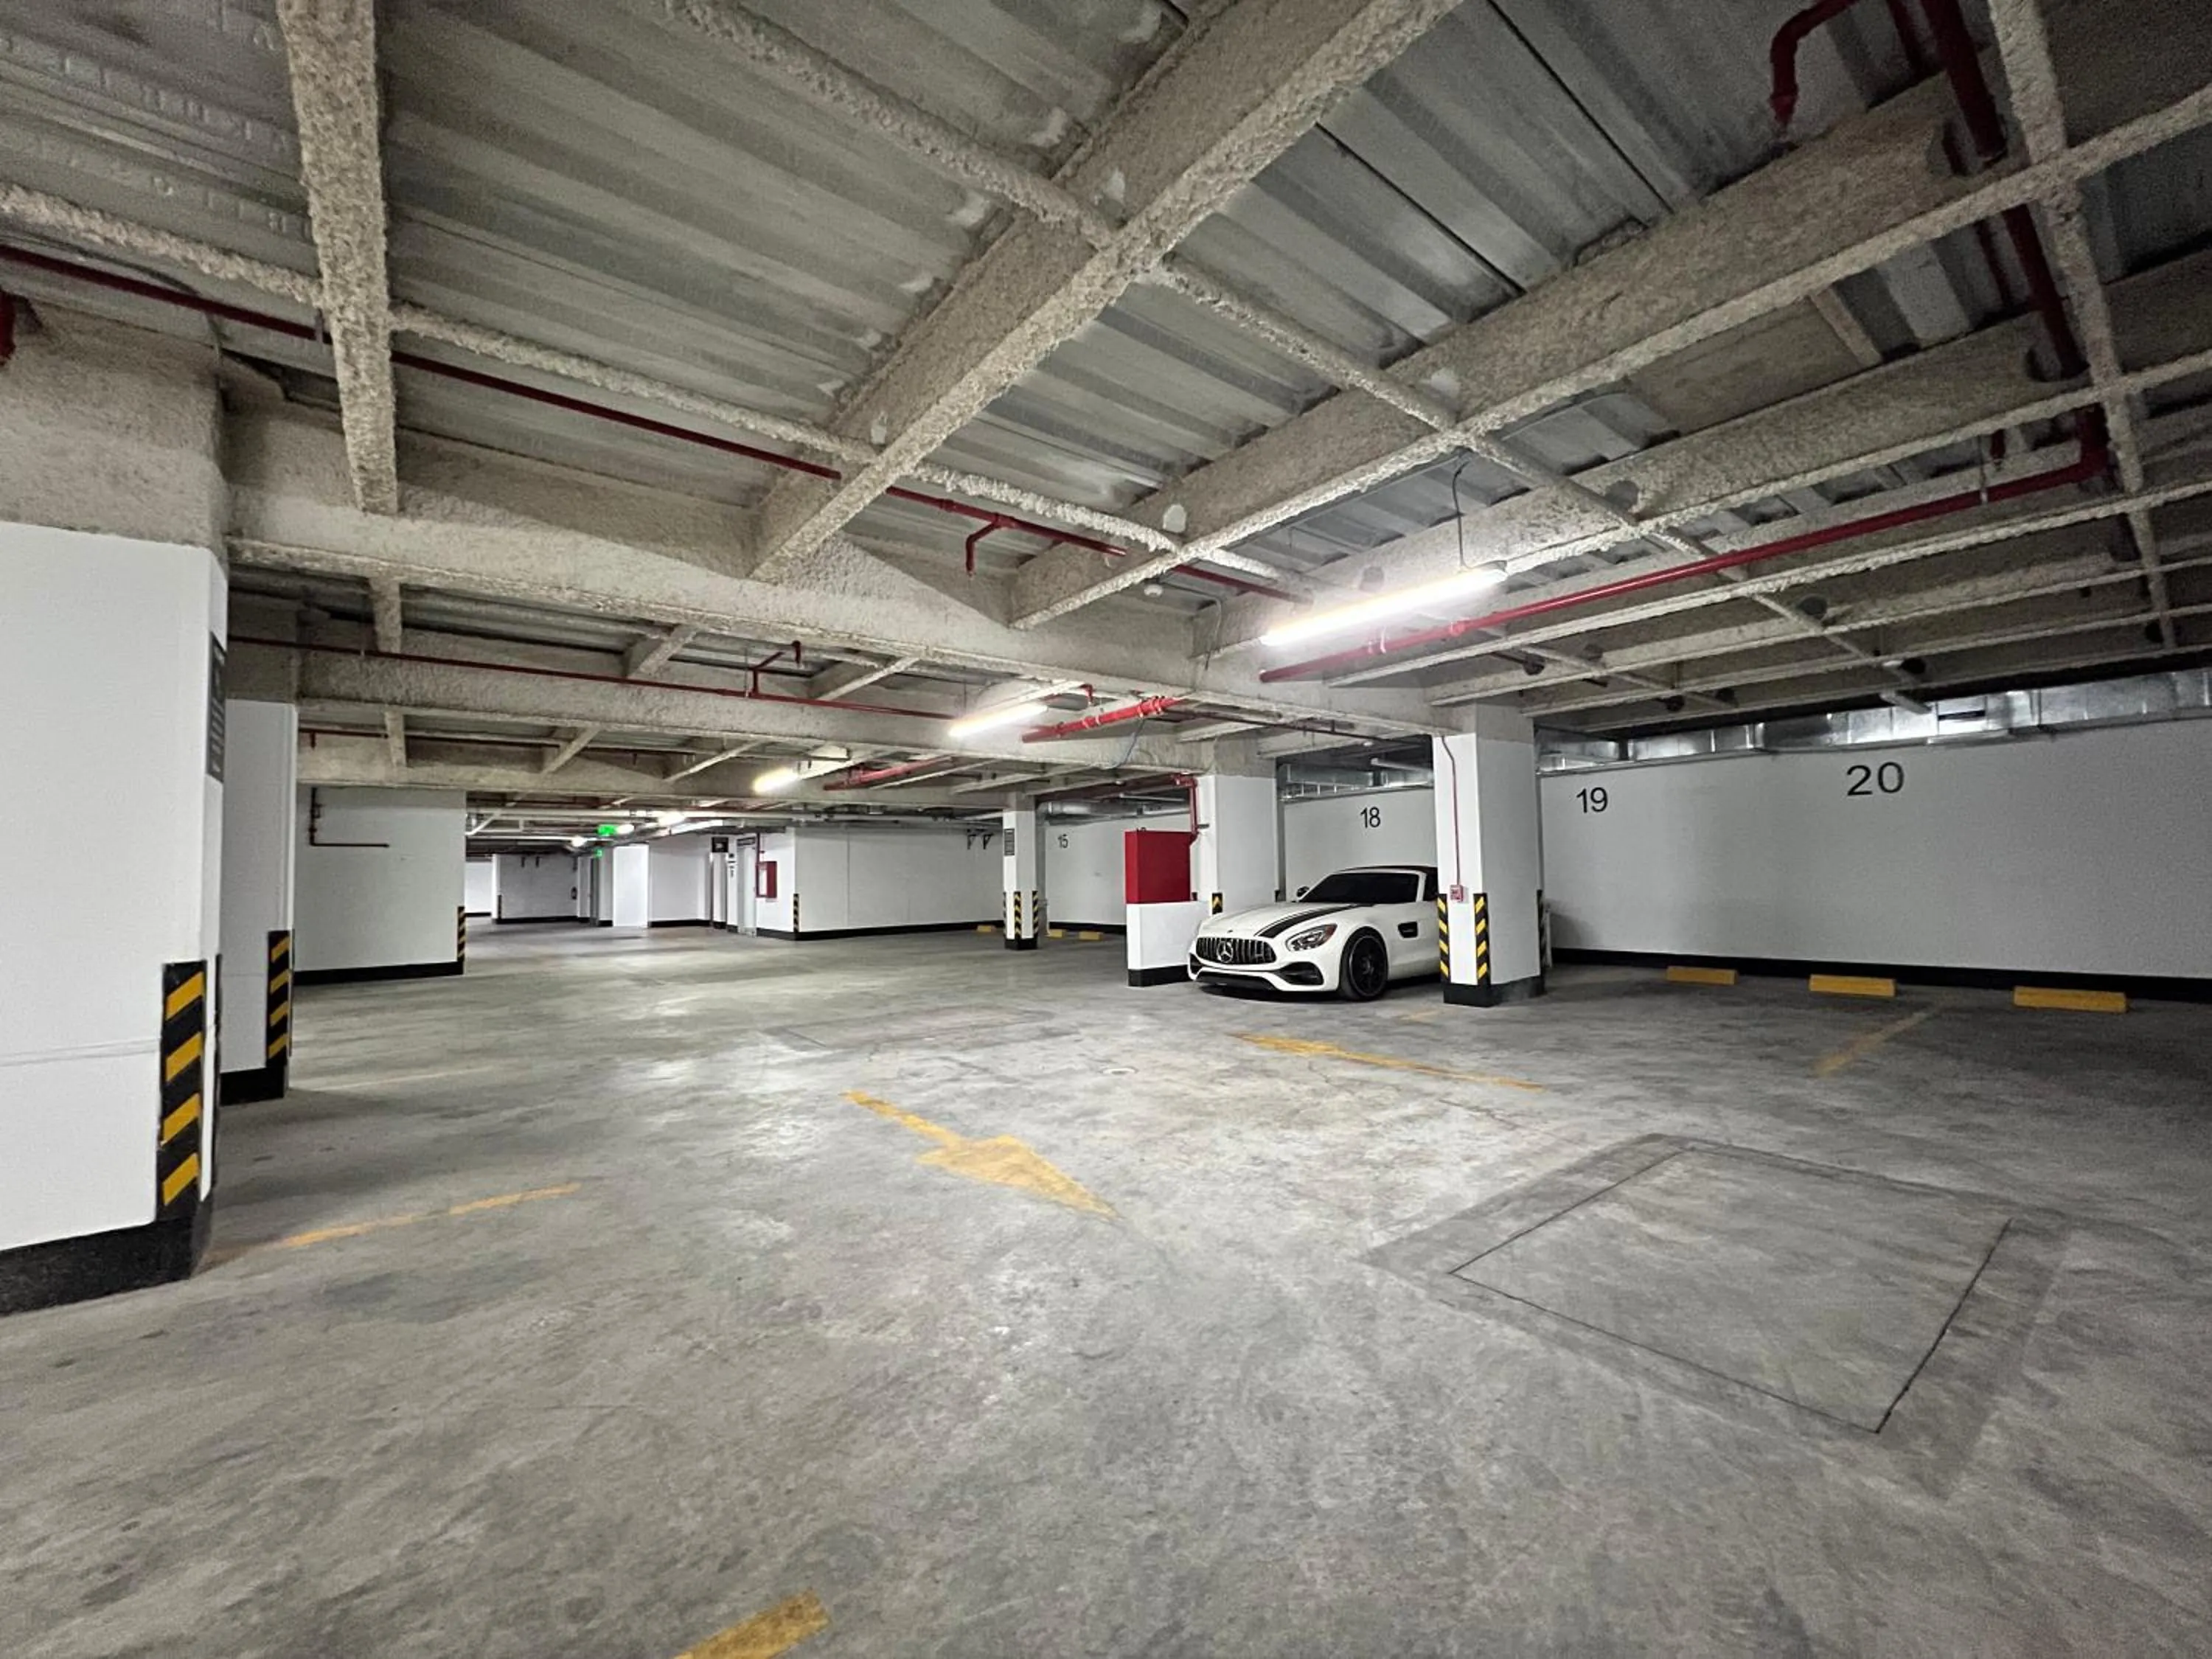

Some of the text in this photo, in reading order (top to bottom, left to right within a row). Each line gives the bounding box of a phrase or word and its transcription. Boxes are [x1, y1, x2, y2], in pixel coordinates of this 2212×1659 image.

[1846, 762, 1905, 796] 20
[1576, 787, 1608, 813] 19
[1360, 807, 1381, 828] 18
[1057, 834, 1068, 849] 15
